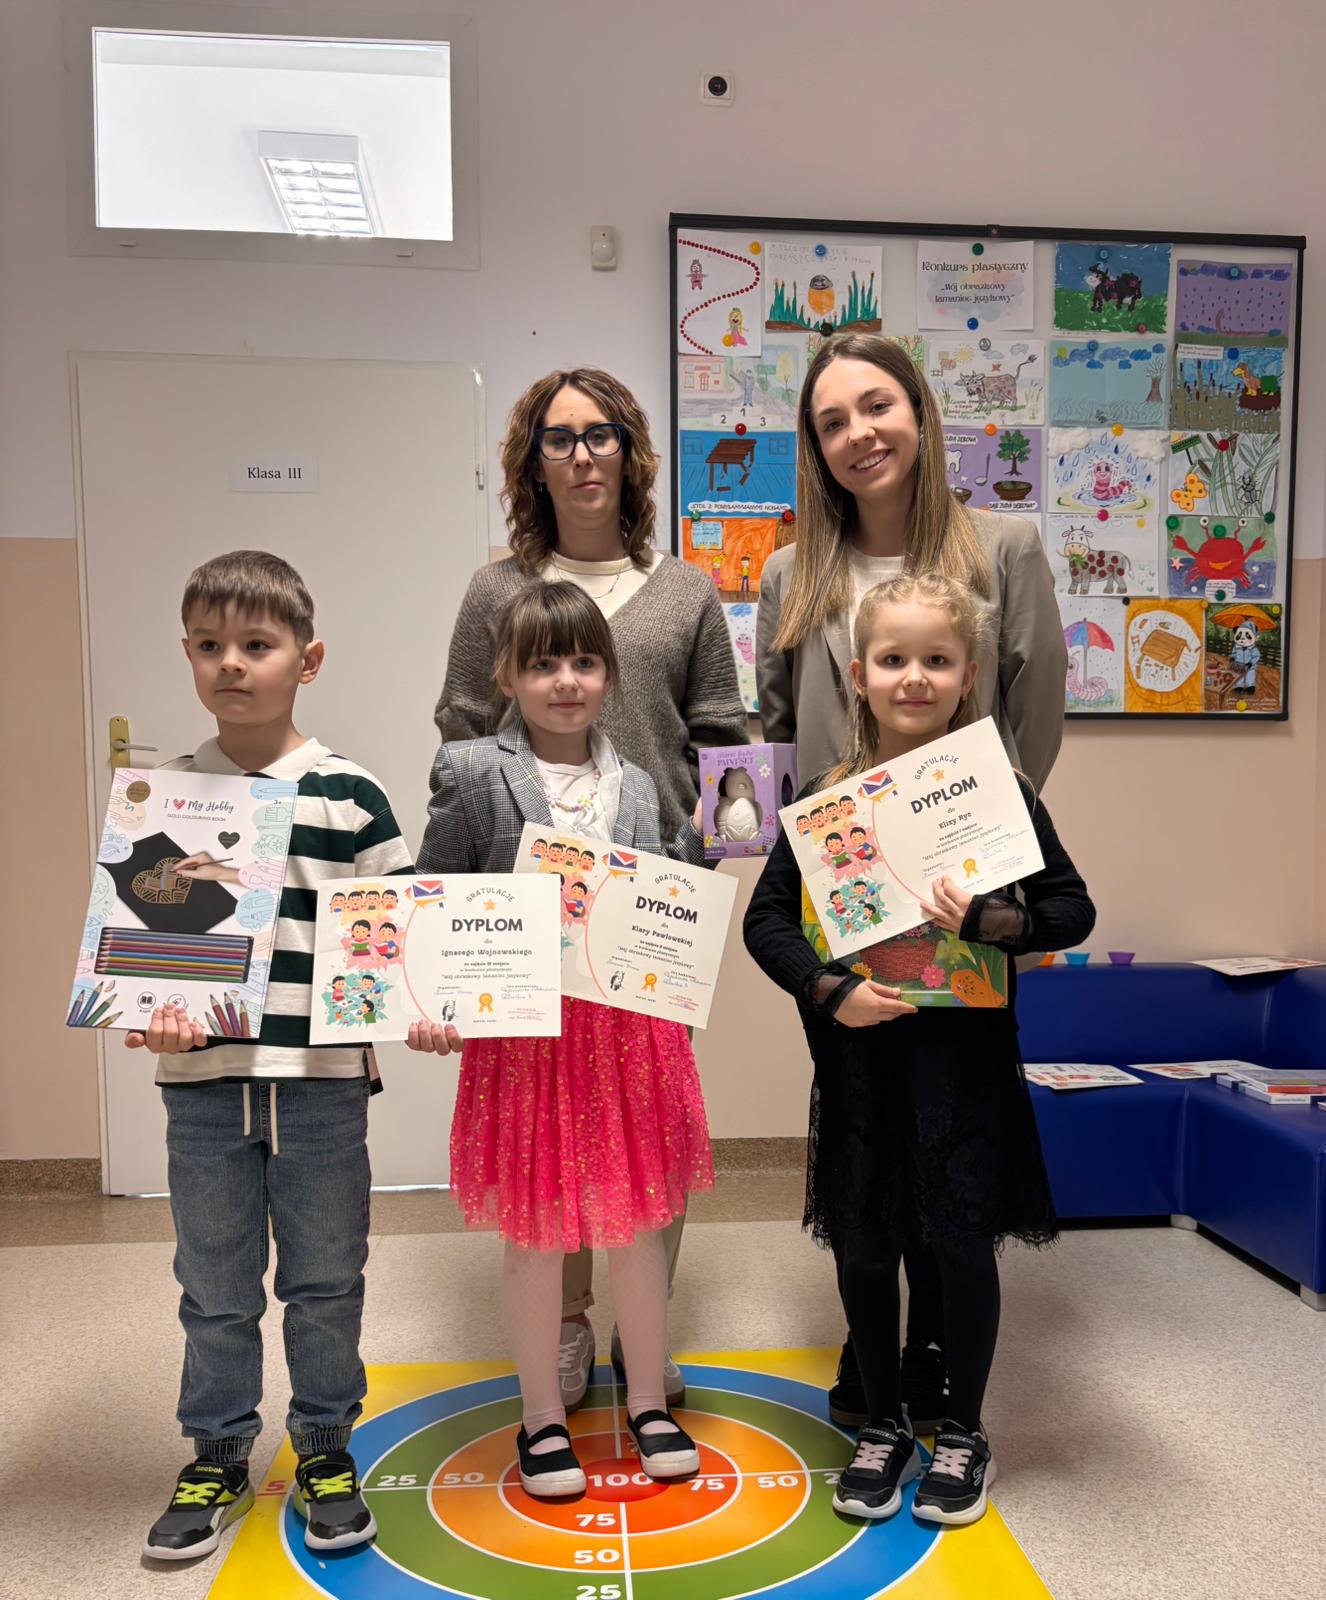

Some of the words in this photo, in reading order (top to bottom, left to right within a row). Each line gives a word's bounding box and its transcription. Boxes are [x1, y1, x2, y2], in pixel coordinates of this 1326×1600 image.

[922, 261, 968, 272] Konkurs
[972, 262, 1029, 274] plastyczny
[960, 282, 1006, 292] obrazkowy
[935, 294, 972, 303] łamaniec
[720, 414, 727, 424] 2
[740, 408, 746, 417] 1
[760, 417, 766, 426] 3
[248, 466, 281, 479] Klasa
[288, 467, 302, 479] III
[914, 754, 959, 780] GRATULACJE
[910, 776, 978, 814] DYPLOM
[164, 799, 169, 809] I
[187, 800, 203, 812] My
[206, 801, 234, 814] Hobby
[654, 873, 696, 894] GRATULACJE
[466, 887, 516, 903] GRATULACJE
[635, 896, 698, 924] DYPLOM
[451, 918, 523, 932] DYPLOM
[632, 925, 650, 936] Klary
[194, 1465, 223, 1474] Reebok
[377, 1473, 417, 1487] 25
[443, 1471, 485, 1485] 50
[588, 1473, 654, 1487] 100
[688, 1478, 726, 1491] 75
[757, 1475, 799, 1488] 50
[575, 1513, 616, 1527] 75
[574, 1549, 620, 1564] 50
[576, 1584, 621, 1600] 25
